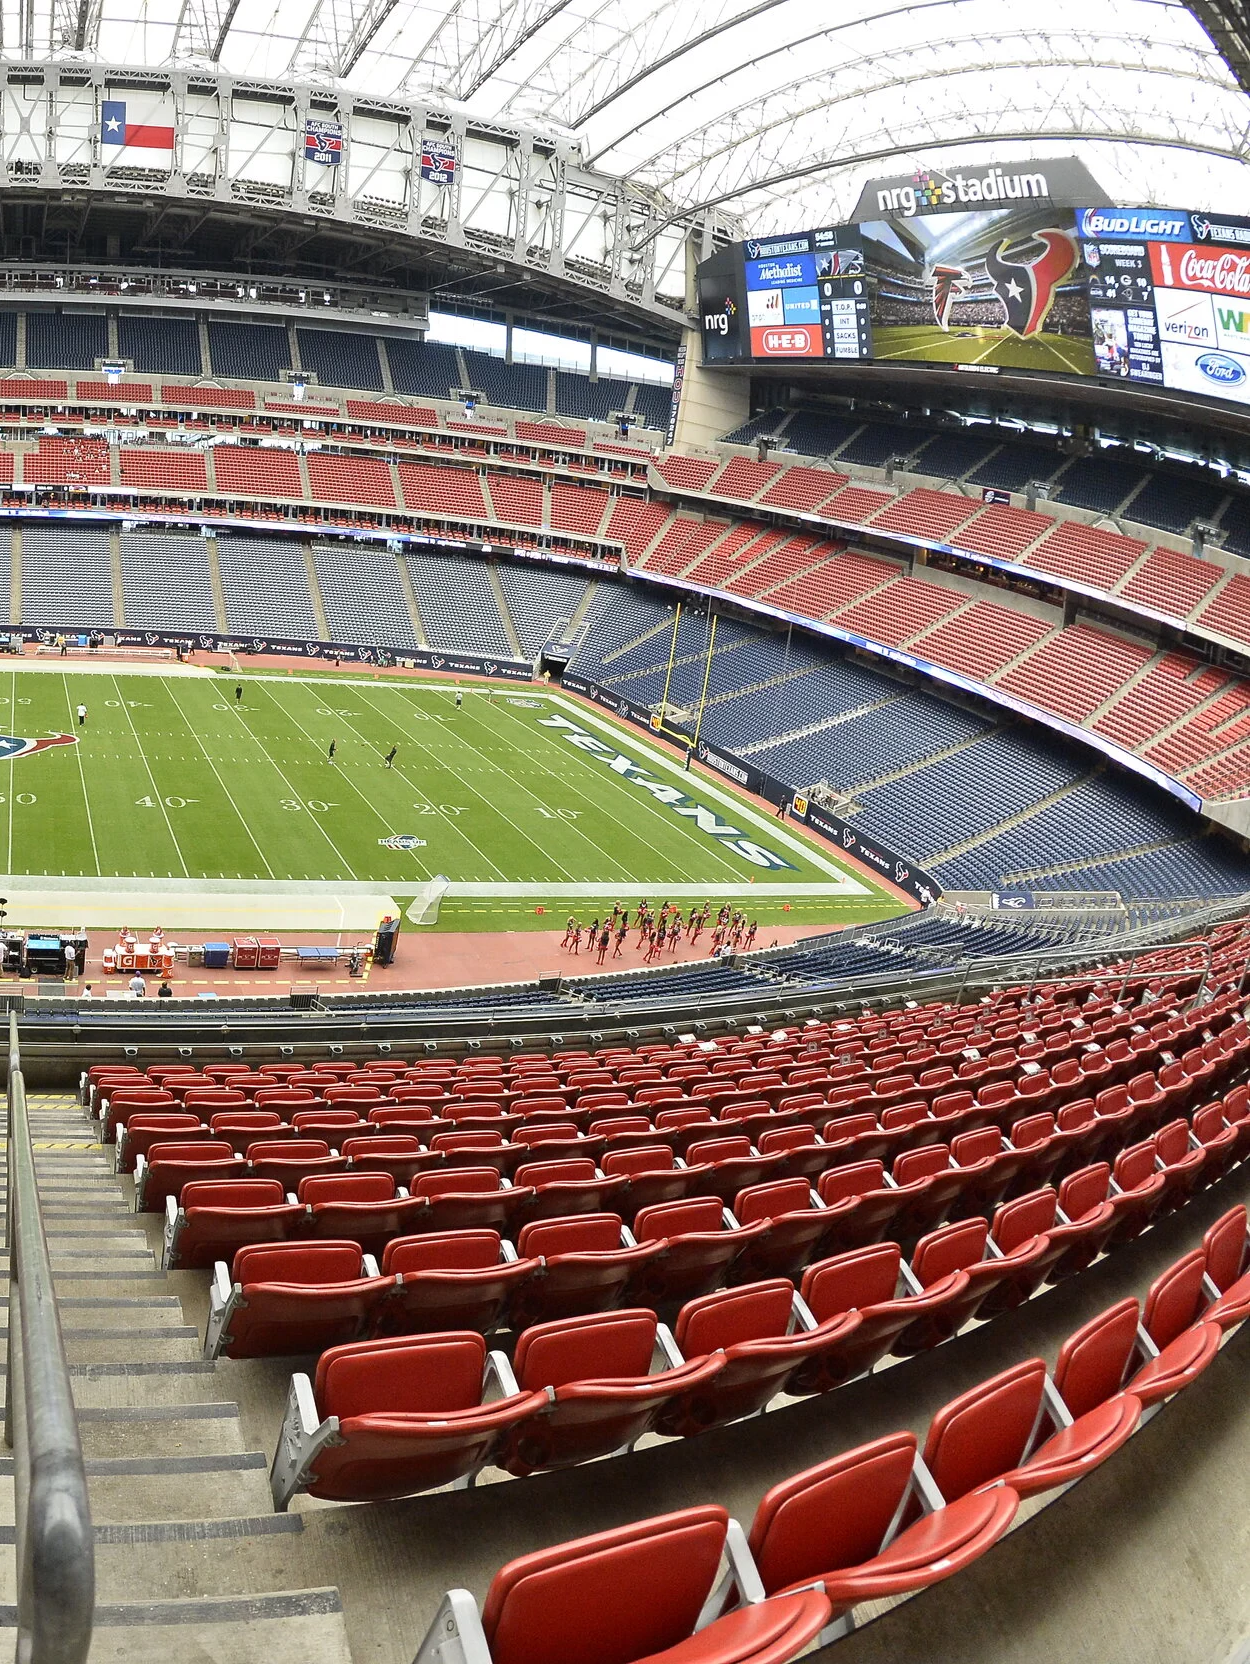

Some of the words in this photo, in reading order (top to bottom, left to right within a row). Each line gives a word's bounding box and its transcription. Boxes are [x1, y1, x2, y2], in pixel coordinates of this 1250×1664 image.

[306, 125, 342, 136] CHAMPIONS
[314, 152, 332, 163] 2011
[423, 145, 455, 156] CHAMPIONS
[429, 171, 448, 182] 2012
[877, 186, 917, 217] nrg
[941, 168, 1049, 204] stadium
[1090, 215, 1130, 233] BUD
[1129, 217, 1184, 235] LIGHT
[1211, 226, 1235, 240] TEXANS
[759, 240, 810, 257] HOUSTONTEXANS.COM
[1099, 243, 1145, 257] SCOREBOARD
[1115, 259, 1137, 267] WEEK
[1137, 259, 1143, 268] 3
[759, 263, 803, 280] Methodist
[824, 282, 833, 297] 0
[853, 280, 863, 295] 0
[1141, 291, 1149, 301] 7
[785, 302, 810, 310] UNITED
[835, 303, 852, 311] T.O.P.
[705, 313, 729, 336] nrg
[839, 317, 850, 325] INT
[836, 332, 856, 340] SACKS
[1164, 320, 1209, 339] verizon
[835, 346, 858, 354] FUMBLE
[1206, 359, 1234, 379] Ford
[270, 644, 302, 652] TEXANS
[323, 649, 355, 657] TEXANS
[449, 662, 480, 671] TEXANS
[501, 668, 533, 677] TEXANS
[563, 679, 587, 691] TEXANS
[599, 694, 618, 708] TEXANS
[631, 710, 649, 725] TEXANS
[706, 751, 749, 785] HOUSTONTEXANS.COM
[537, 714, 802, 872] TEXANS
[135, 795, 187, 809] 40
[280, 798, 330, 813] 30
[794, 799, 806, 814] 40
[414, 802, 464, 817] 20
[810, 814, 839, 836] TEXANS
[859, 845, 890, 870] TEXANS
[123, 956, 133, 965] G
